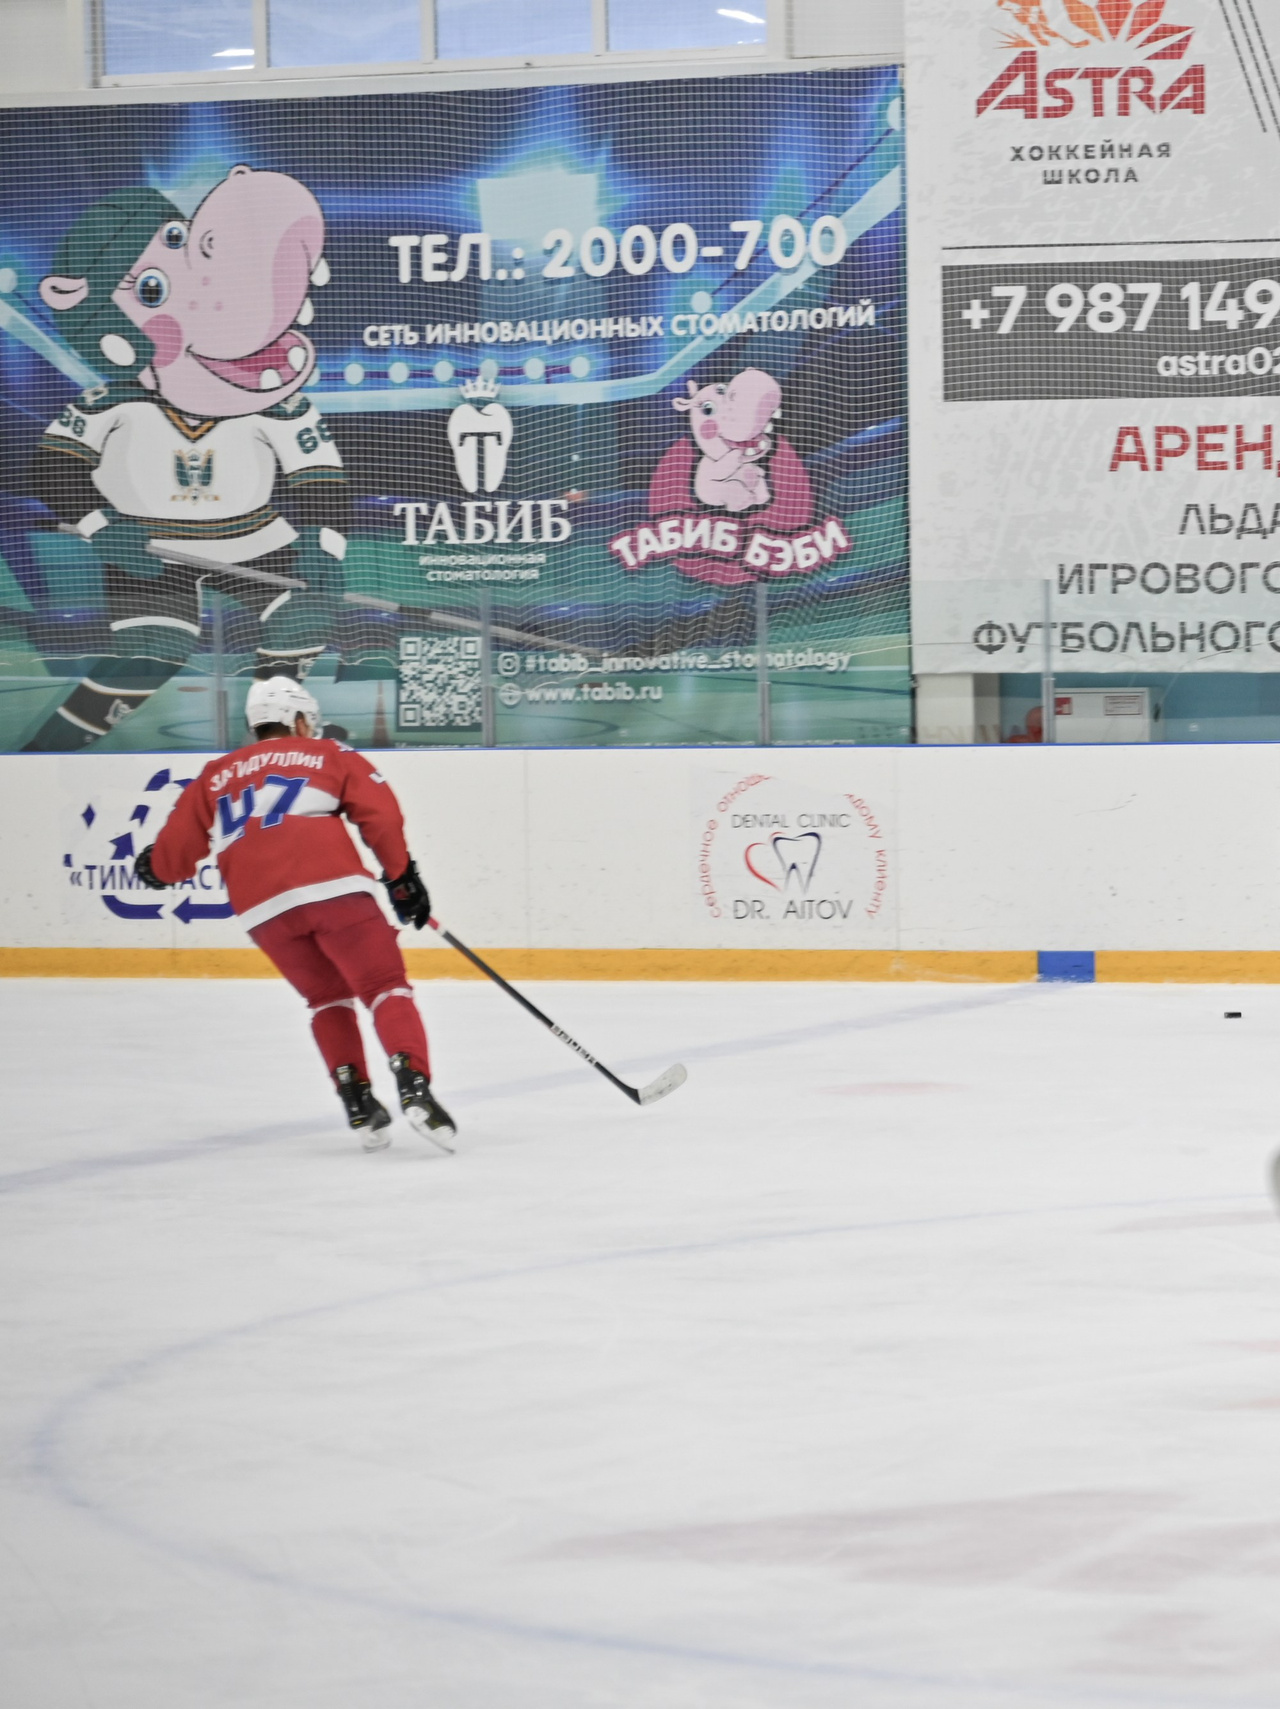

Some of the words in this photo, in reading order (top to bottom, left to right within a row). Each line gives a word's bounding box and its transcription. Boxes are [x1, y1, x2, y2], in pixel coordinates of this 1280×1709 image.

[974, 50, 1206, 119] ASTRA
[1009, 139, 1172, 162] ХОККЕЙНАЯ
[1042, 167, 1140, 185] ШКОЛА
[388, 233, 526, 284] ТЕЛ.:
[541, 215, 848, 279] 2000-700
[363, 323, 420, 347] СЕТЬ
[425, 315, 665, 346] ИННОВАЦИОННЫХ
[671, 299, 876, 336] СТОМАТОЛОГИЙ
[961, 285, 1028, 335] +7
[1044, 281, 1163, 334] 987
[393, 499, 572, 546] ТАБИБ
[610, 517, 738, 567] ТАБИБ
[745, 520, 849, 571] БЭБИ
[526, 682, 664, 701] www.tabib.ru
[731, 814, 791, 828] DENTAL
[796, 814, 851, 828] CLINIC
[732, 899, 771, 920] DR.
[782, 899, 854, 920] AITOV
